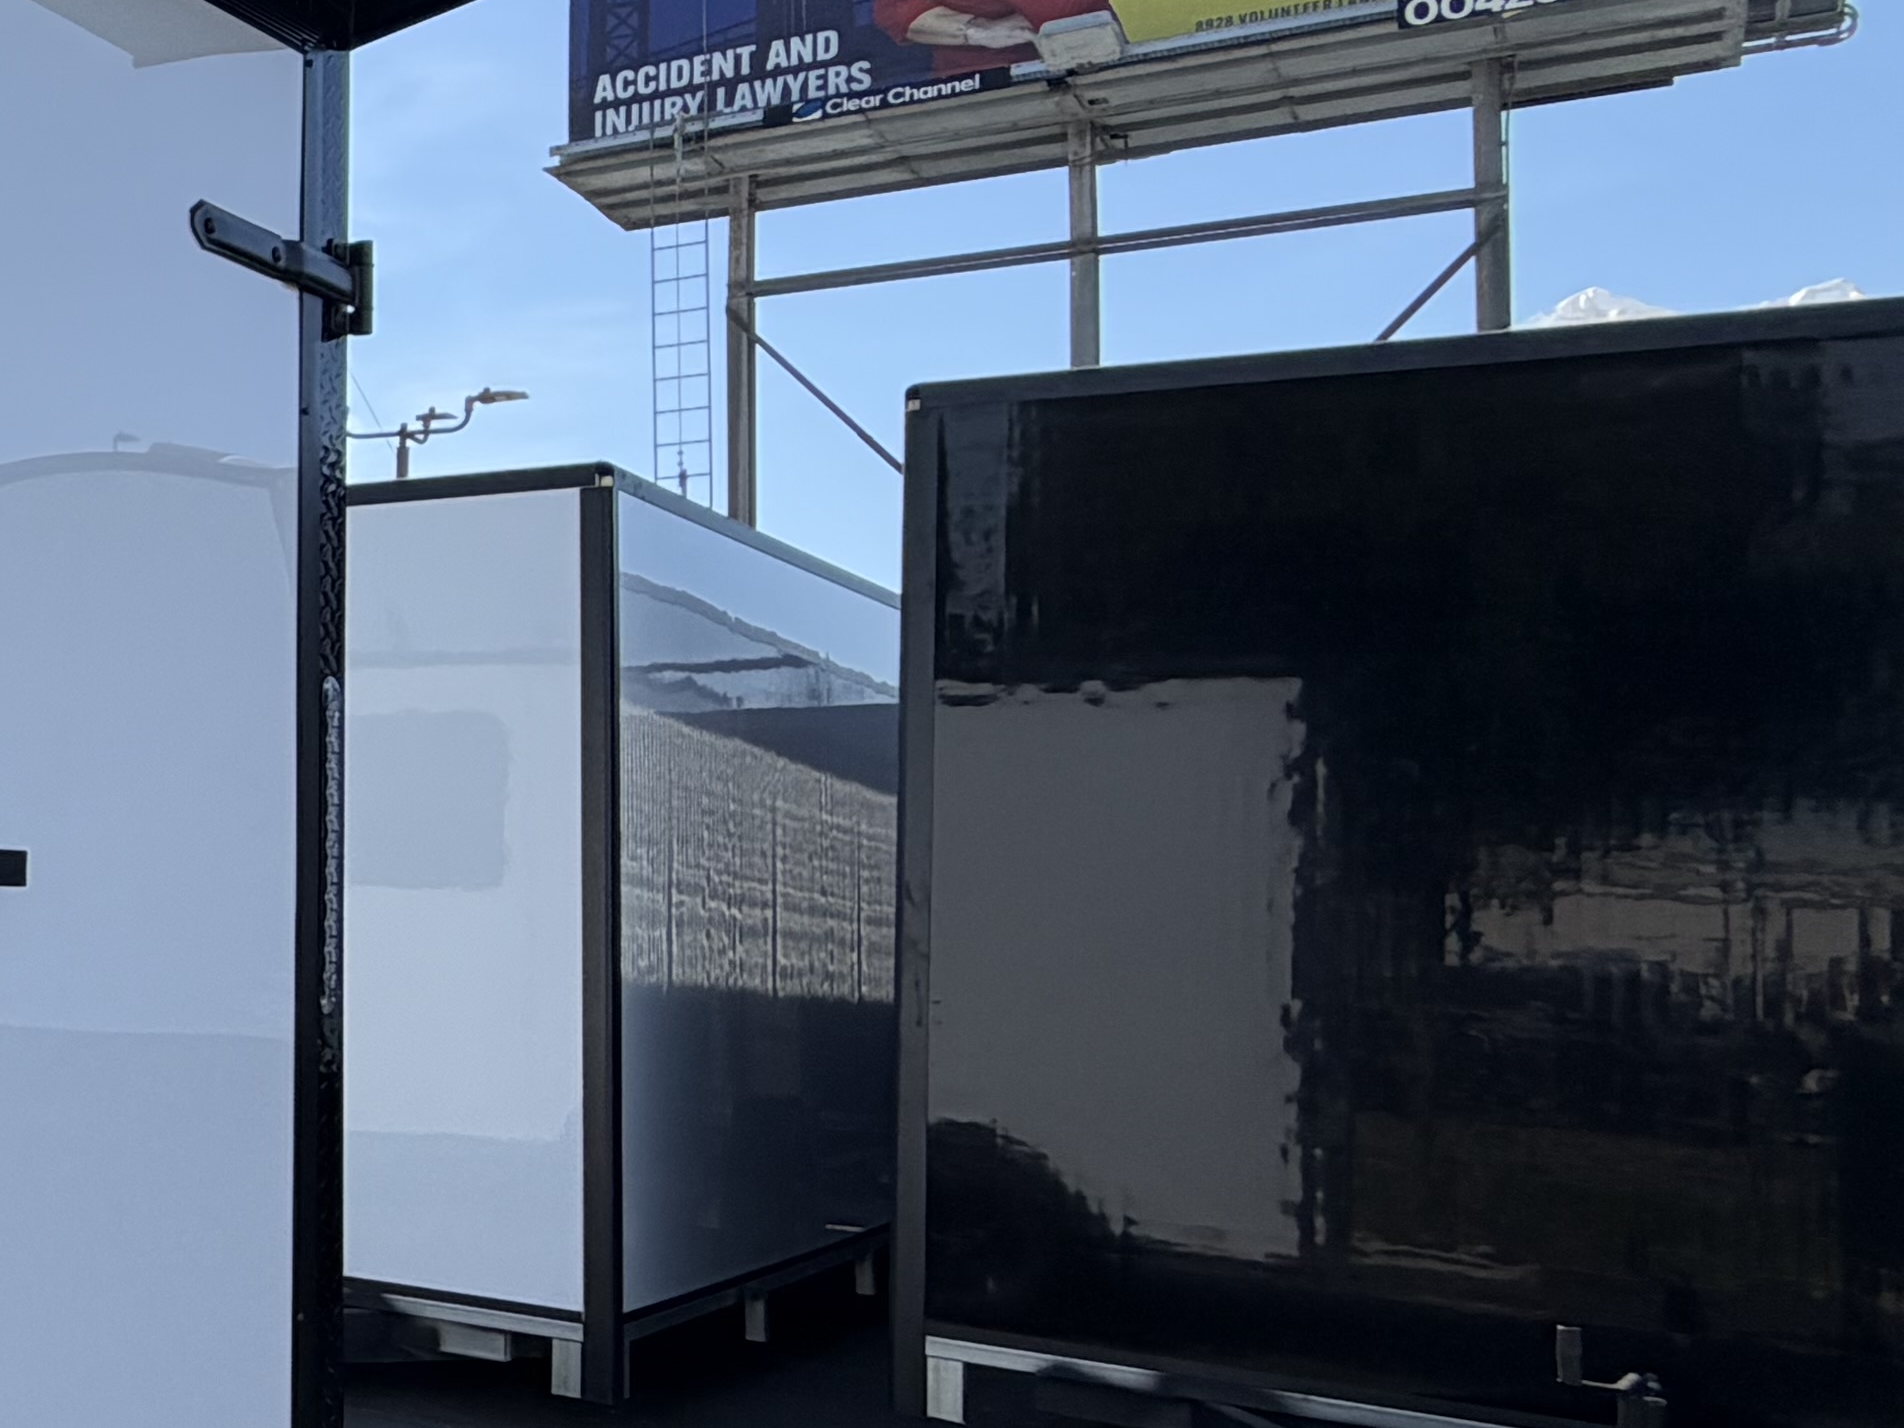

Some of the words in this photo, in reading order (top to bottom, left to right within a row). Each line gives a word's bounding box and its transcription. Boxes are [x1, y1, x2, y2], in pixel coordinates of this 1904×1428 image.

[594, 44, 756, 104] ACCIDENT
[765, 30, 840, 70] AND
[716, 61, 872, 113] LAWYERS
[825, 91, 885, 116] Clear
[887, 74, 980, 105] Channel
